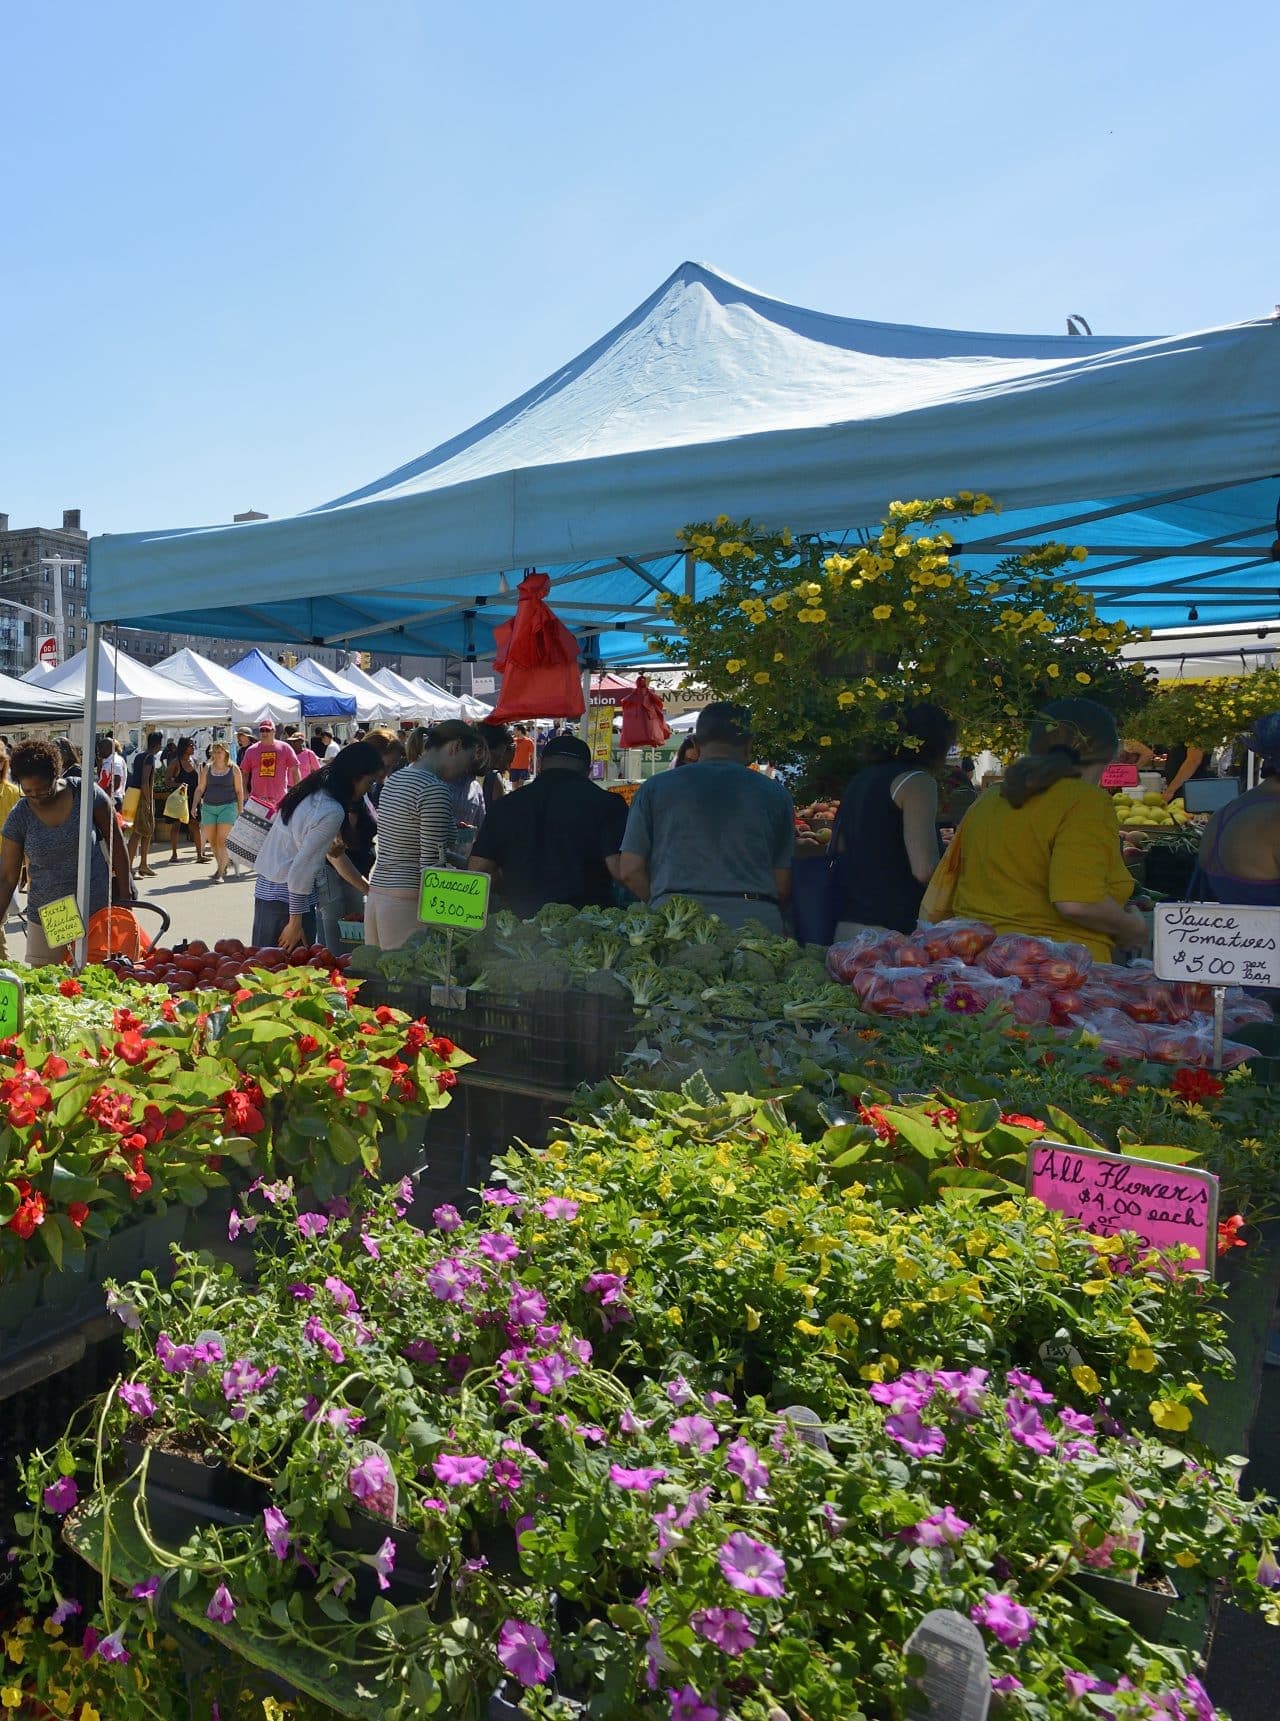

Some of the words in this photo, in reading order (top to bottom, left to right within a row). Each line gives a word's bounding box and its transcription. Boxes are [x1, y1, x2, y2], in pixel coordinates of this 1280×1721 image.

[430, 896, 464, 916] $3.00
[1165, 906, 1240, 929] Sauce
[1168, 928, 1276, 950] Tomatoes
[1173, 950, 1235, 974] $5.00
[1032, 1148, 1085, 1184] All
[1095, 1161, 1208, 1204] Flowers
[1078, 1188, 1142, 1216] $4.00
[1147, 1207, 1203, 1227] each
[1097, 1216, 1120, 1226] or
